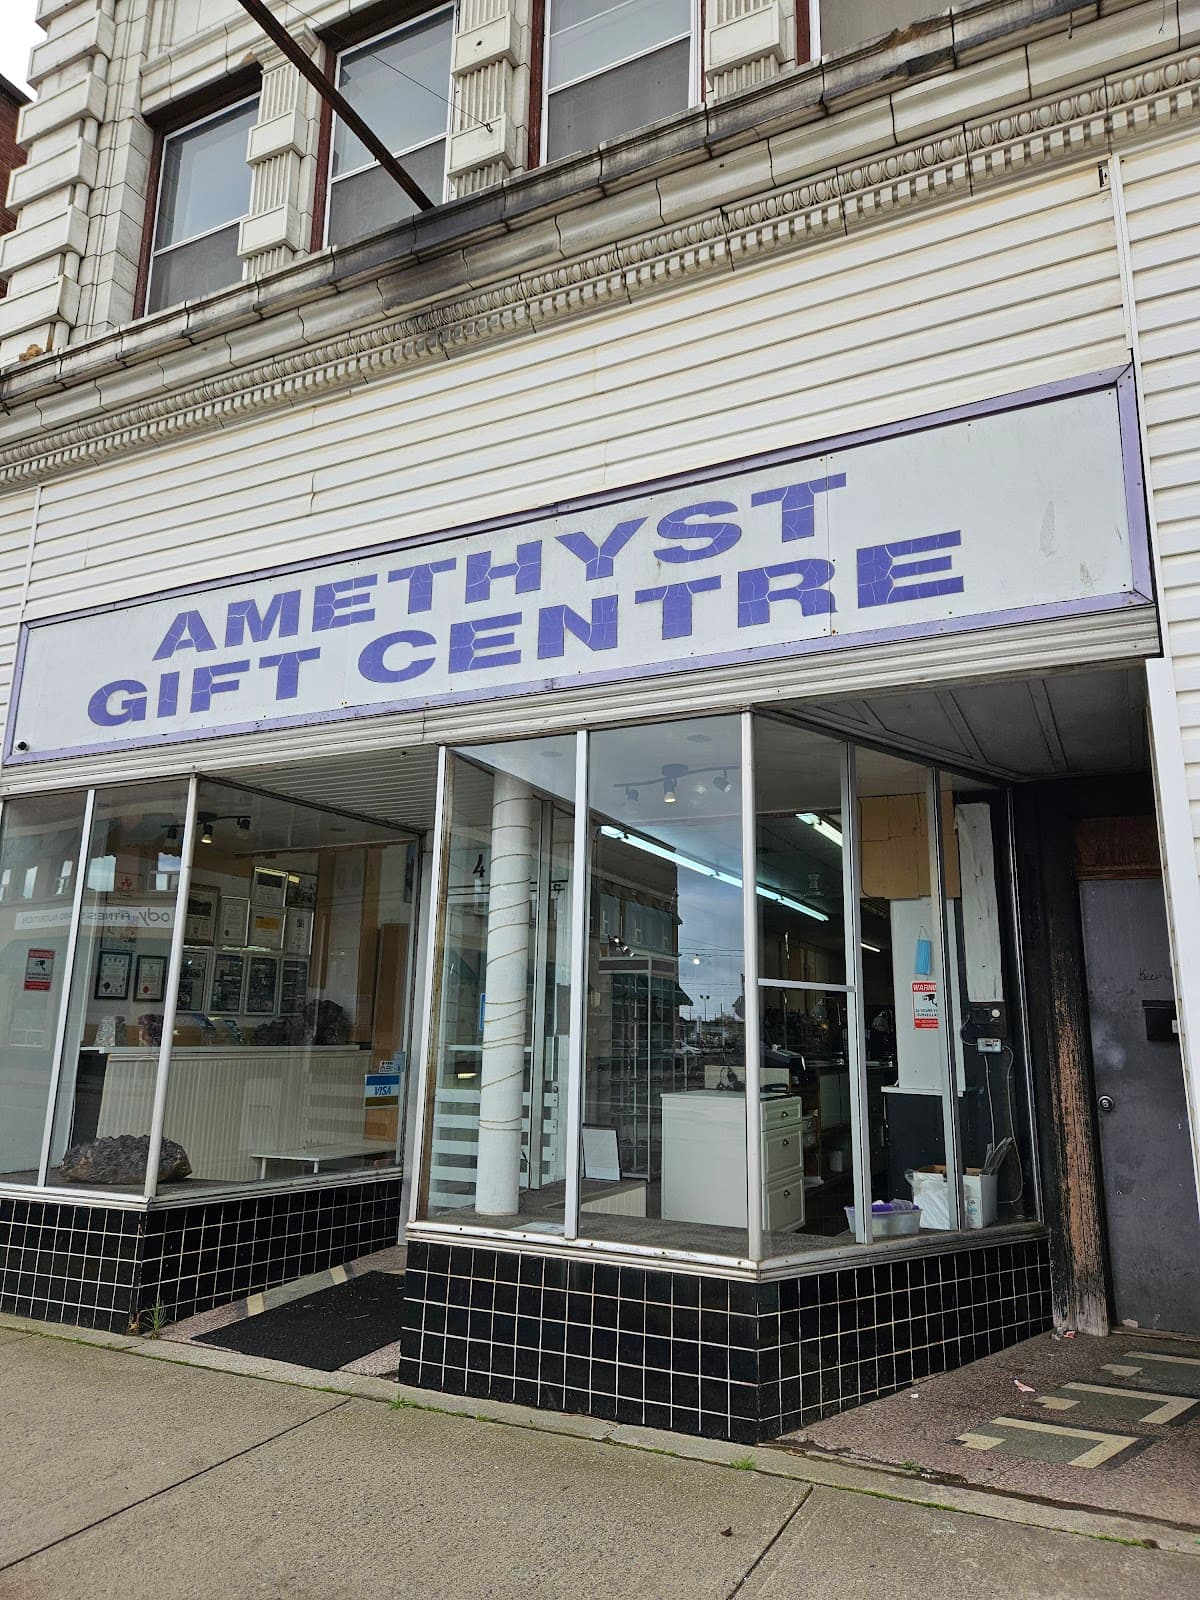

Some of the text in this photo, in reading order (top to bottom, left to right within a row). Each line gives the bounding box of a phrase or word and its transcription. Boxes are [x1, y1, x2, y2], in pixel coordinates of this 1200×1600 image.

[87, 530, 964, 727] GIFT CENTRE
[152, 473, 846, 661] AMETHYST
[374, 1086, 392, 1096] VISA
